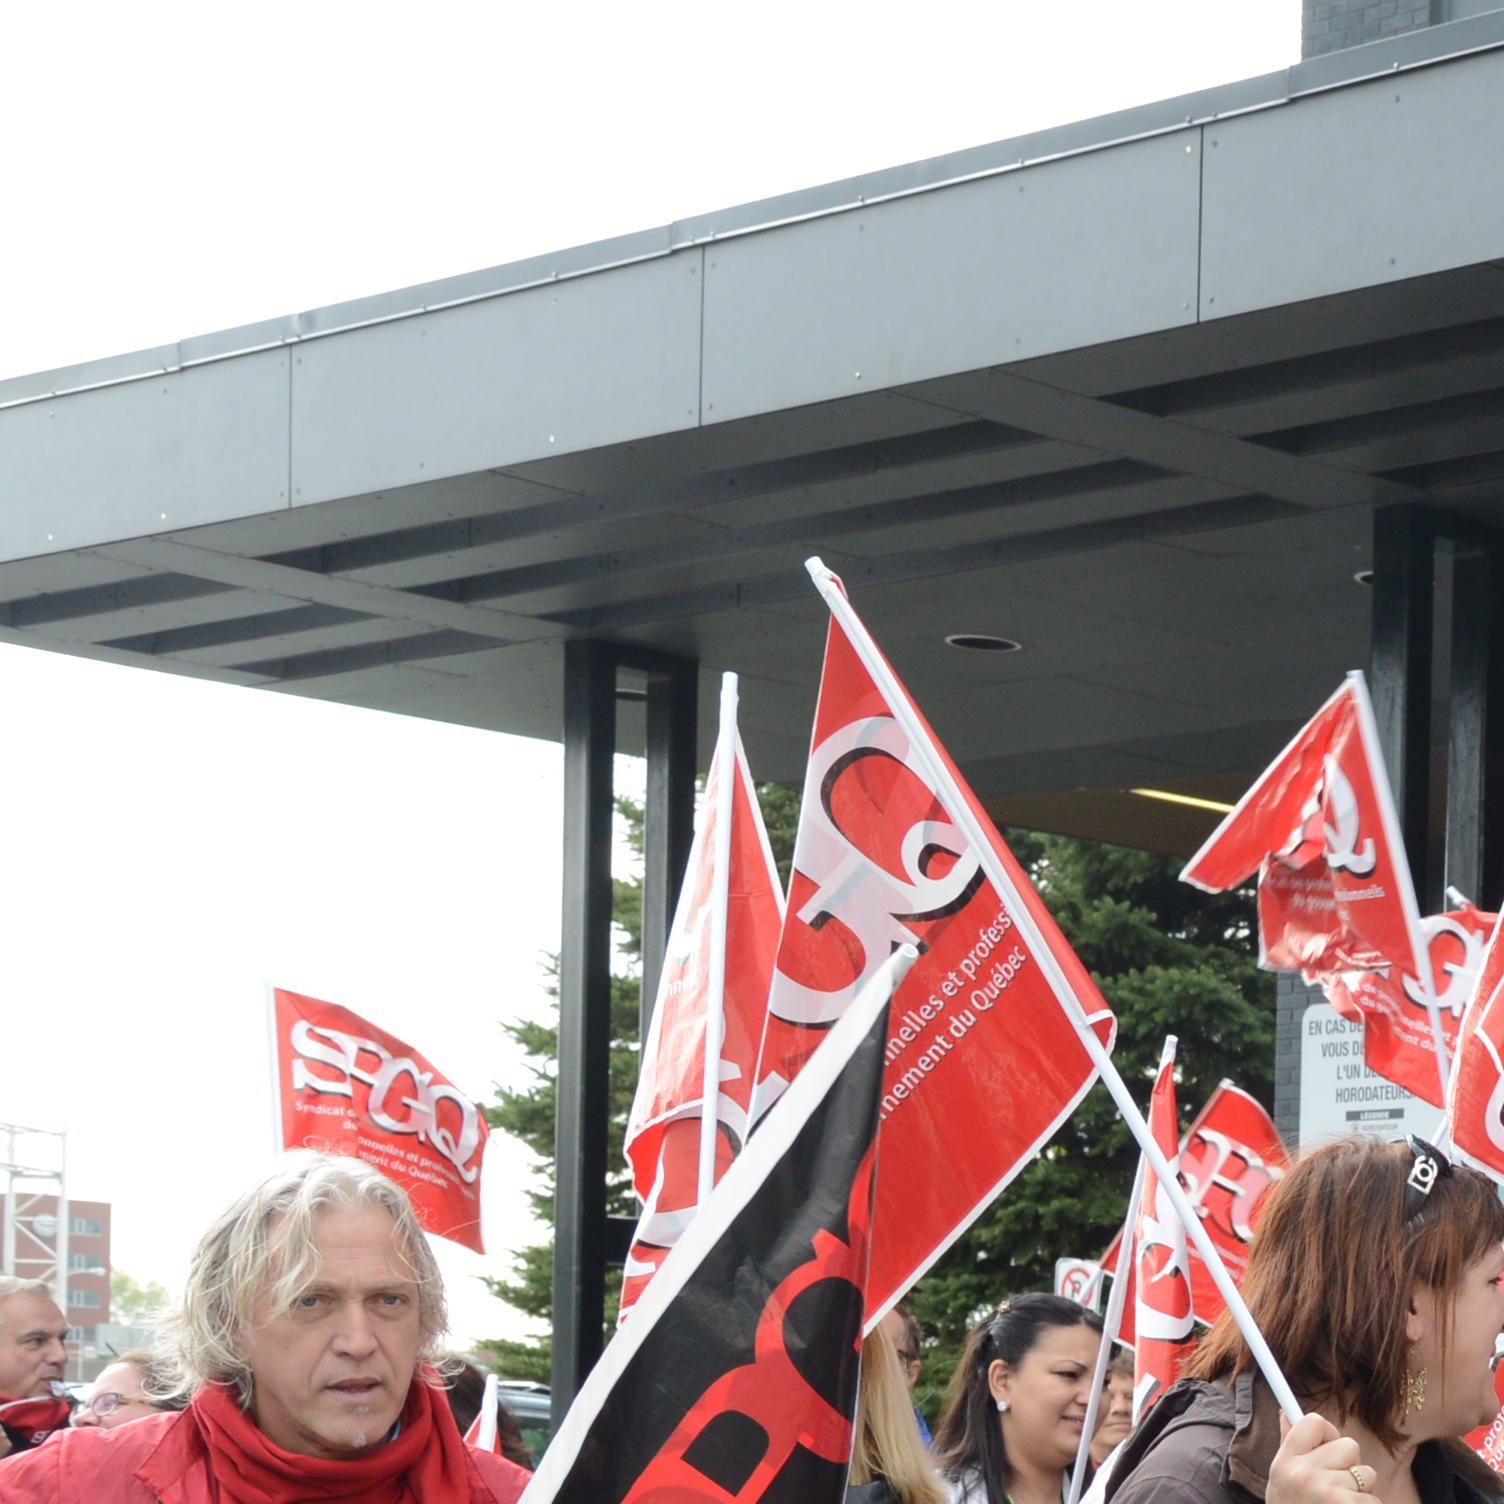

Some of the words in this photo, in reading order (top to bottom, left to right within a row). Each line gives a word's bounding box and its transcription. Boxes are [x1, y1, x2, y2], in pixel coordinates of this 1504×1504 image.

[941, 971, 965, 997] et
[948, 1008, 978, 1040] du
[969, 945, 1027, 1012] Québec
[1308, 1020, 1323, 1036] EN
[1325, 1019, 1346, 1036] CAS
[1321, 1041, 1349, 1058] VOUS
[1336, 1064, 1361, 1080] L'UN
[290, 1018, 480, 1185] SPGQ
[295, 1101, 345, 1117] Syndicat
